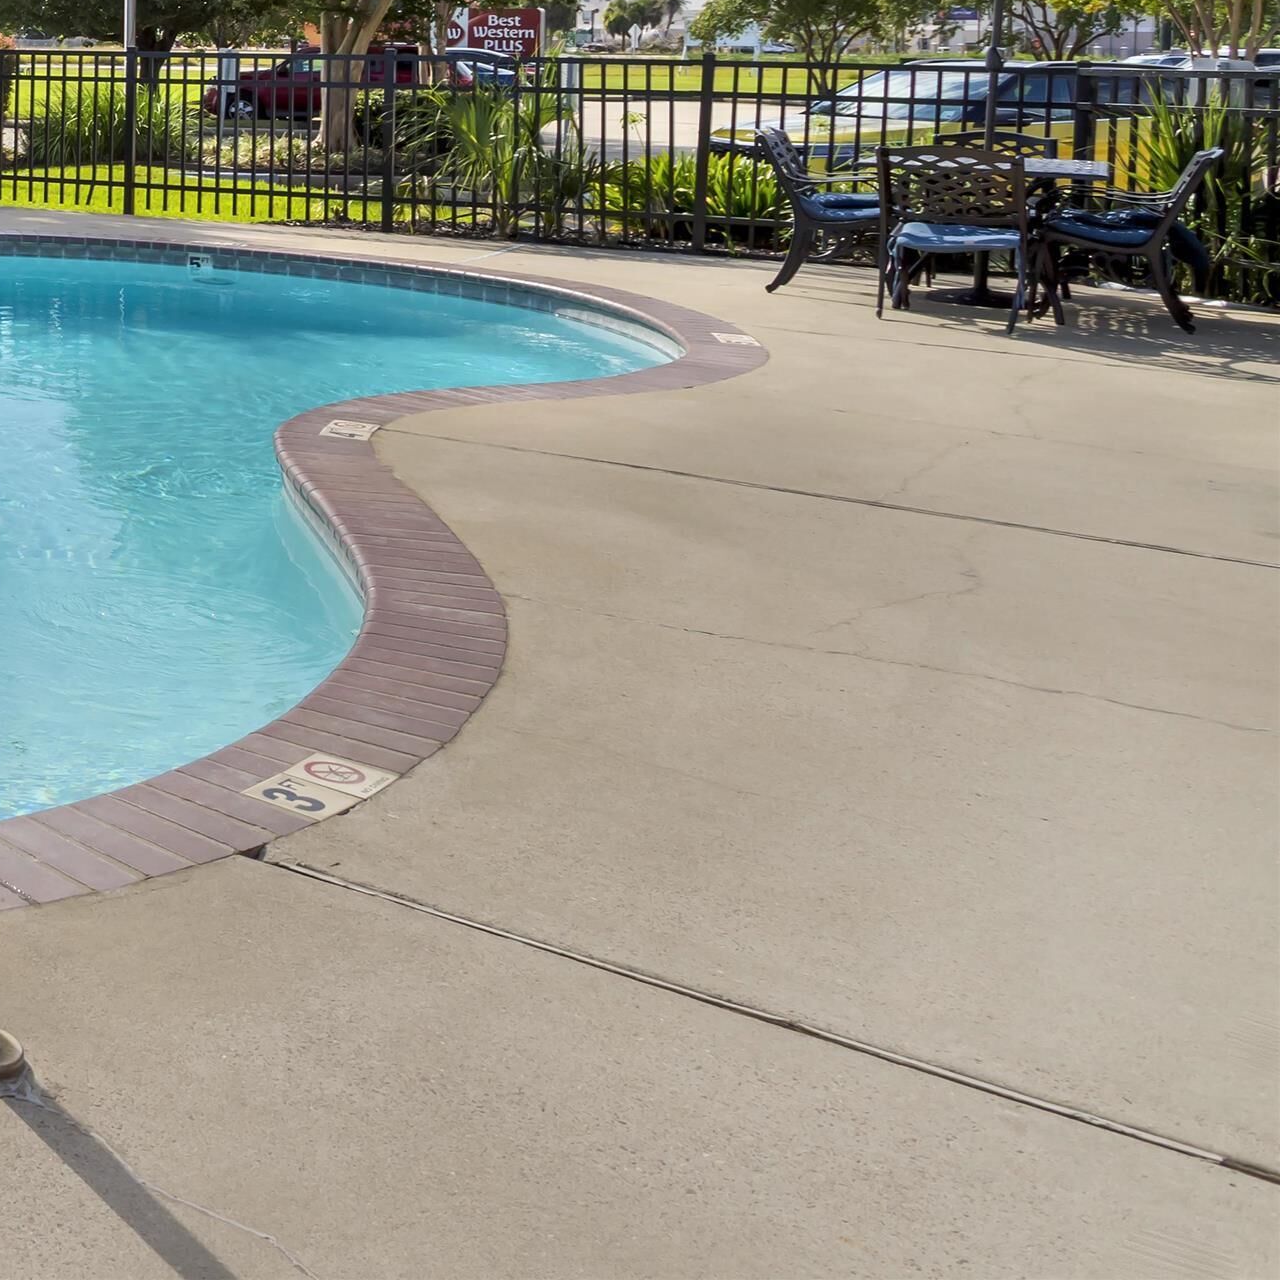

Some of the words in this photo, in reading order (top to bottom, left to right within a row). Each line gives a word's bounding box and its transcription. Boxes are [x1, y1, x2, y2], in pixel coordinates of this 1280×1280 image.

[488, 14, 521, 27] Best
[473, 26, 535, 39] Western
[484, 39, 523, 52] PLUS
[277, 778, 306, 791] FT
[262, 787, 326, 812] 3
